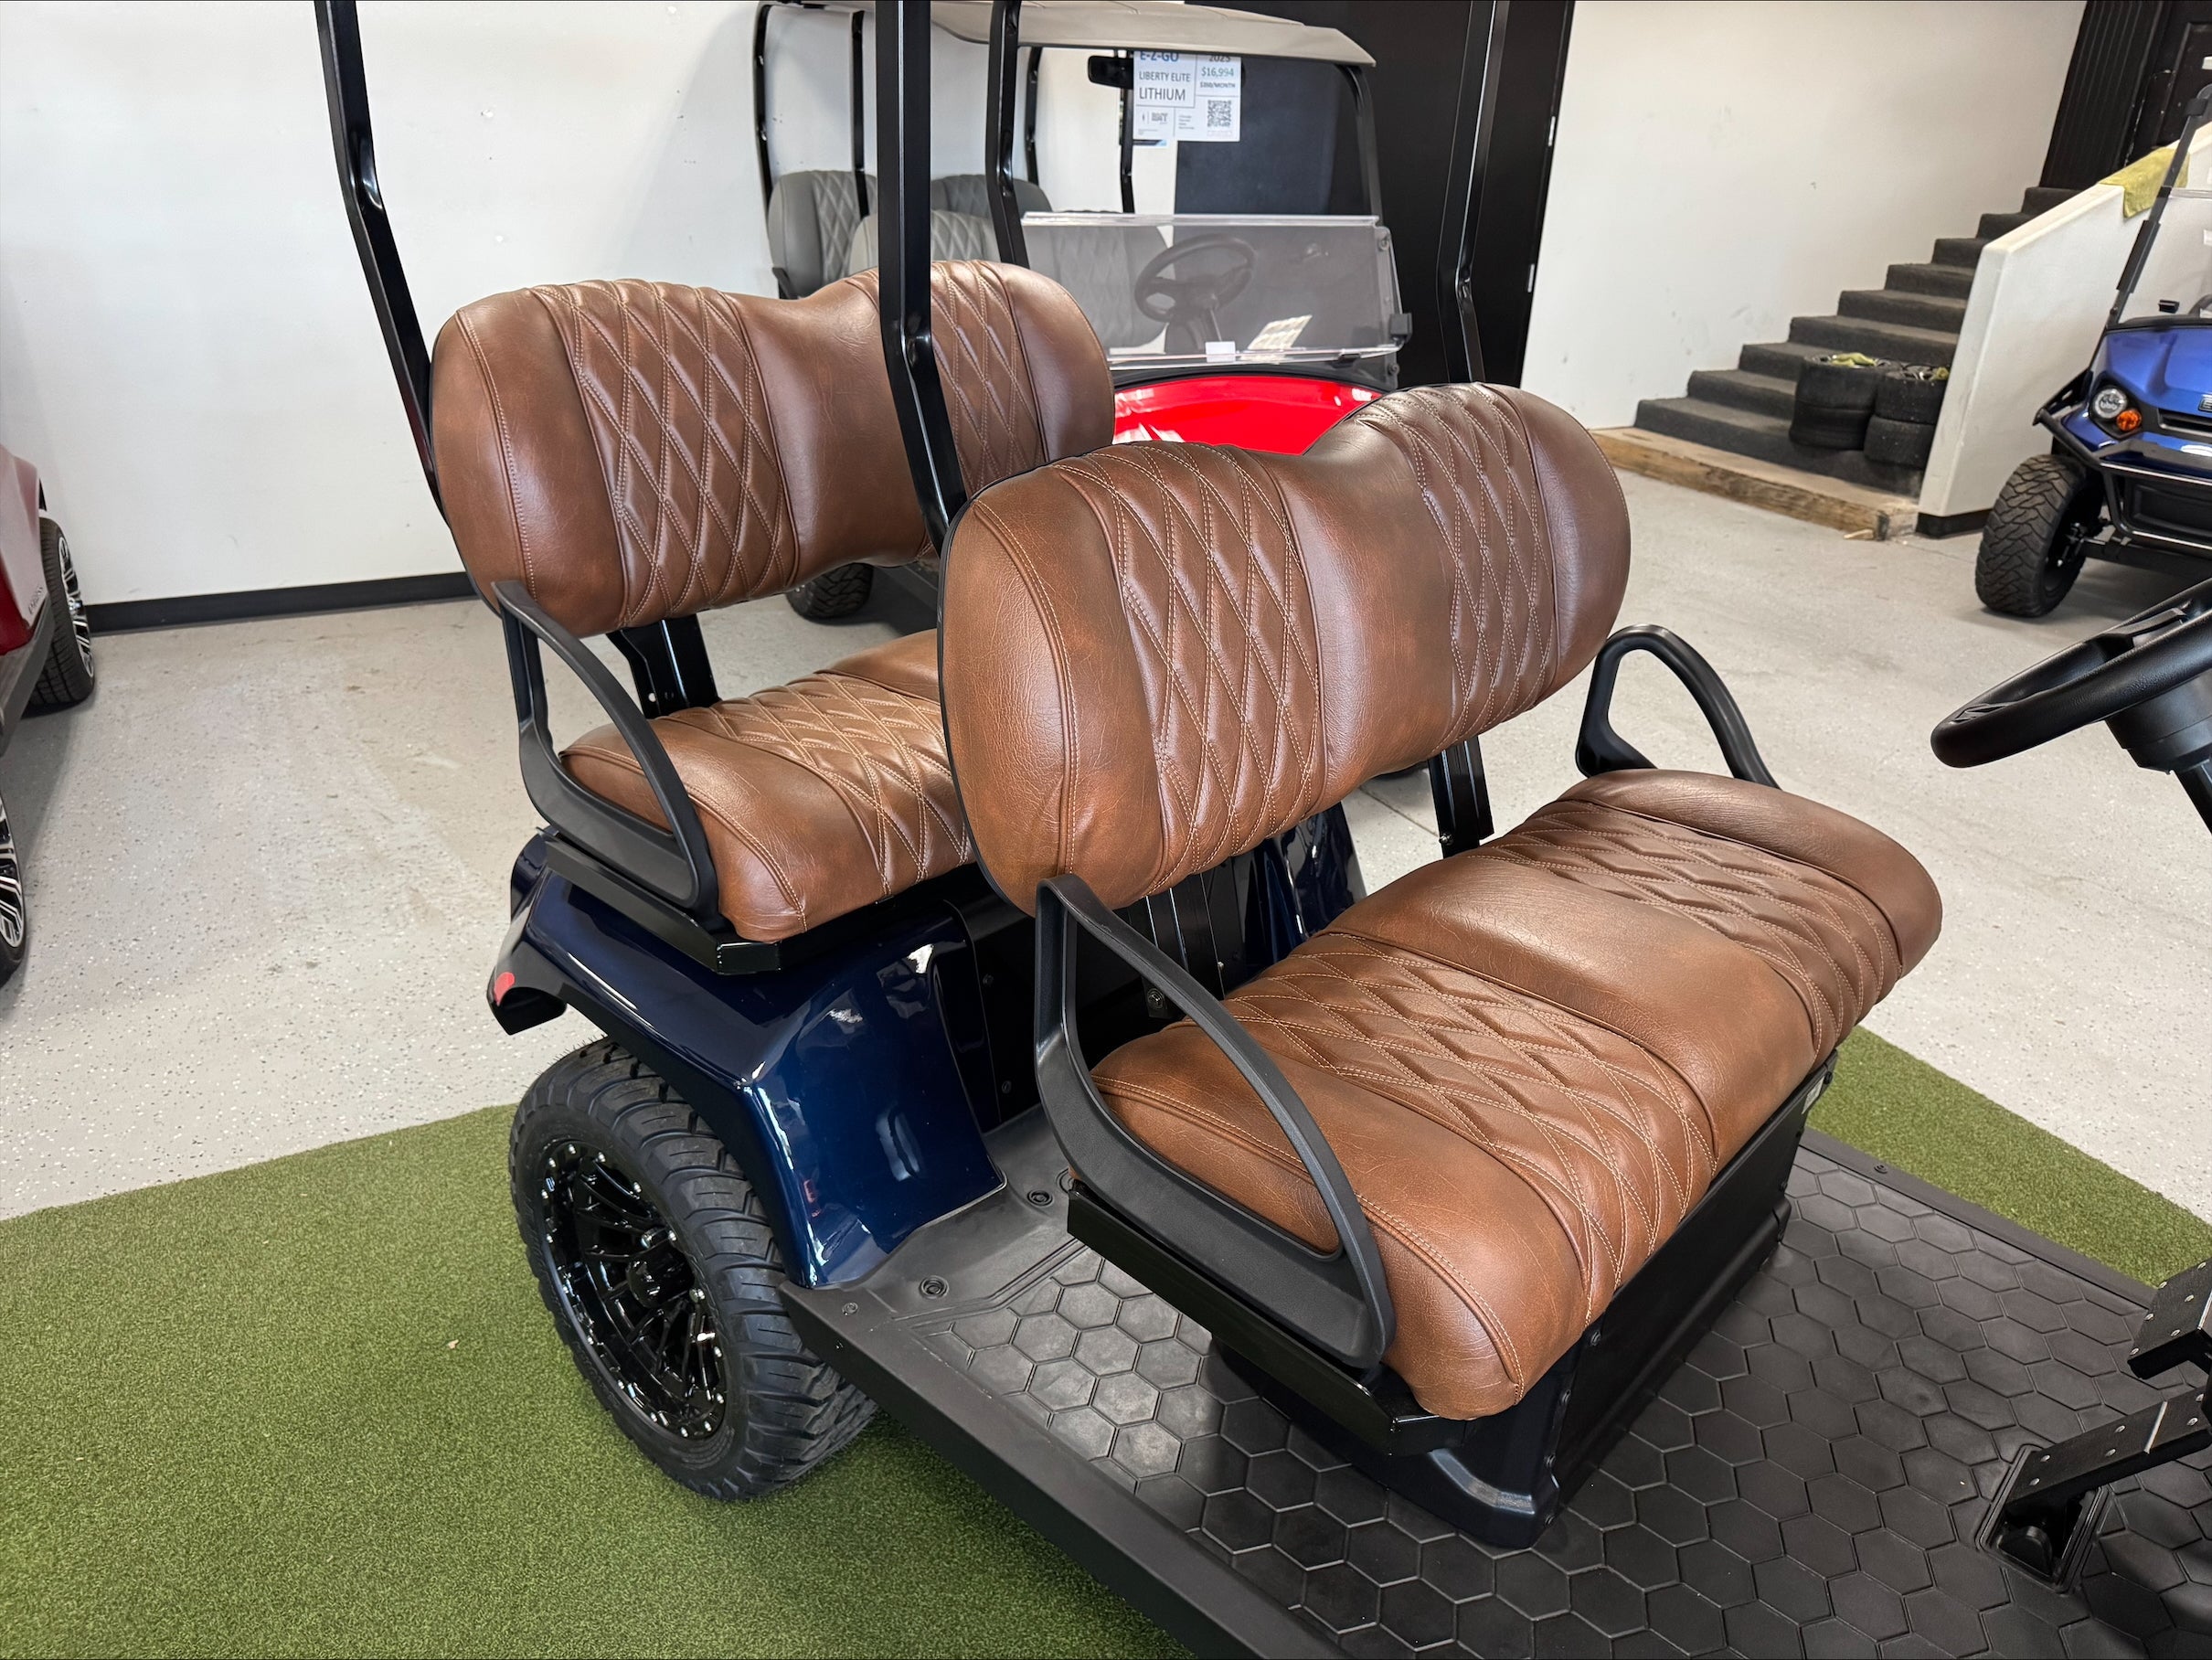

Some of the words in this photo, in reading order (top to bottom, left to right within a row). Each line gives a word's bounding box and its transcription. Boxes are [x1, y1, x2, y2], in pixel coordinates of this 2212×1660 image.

[1140, 50, 1179, 62] E-Z-GO
[1139, 71, 1169, 81] LIBERTY
[1171, 73, 1191, 82] ELITE
[1201, 67, 1234, 78] $16,994
[1139, 88, 1186, 101] LITHIUM
